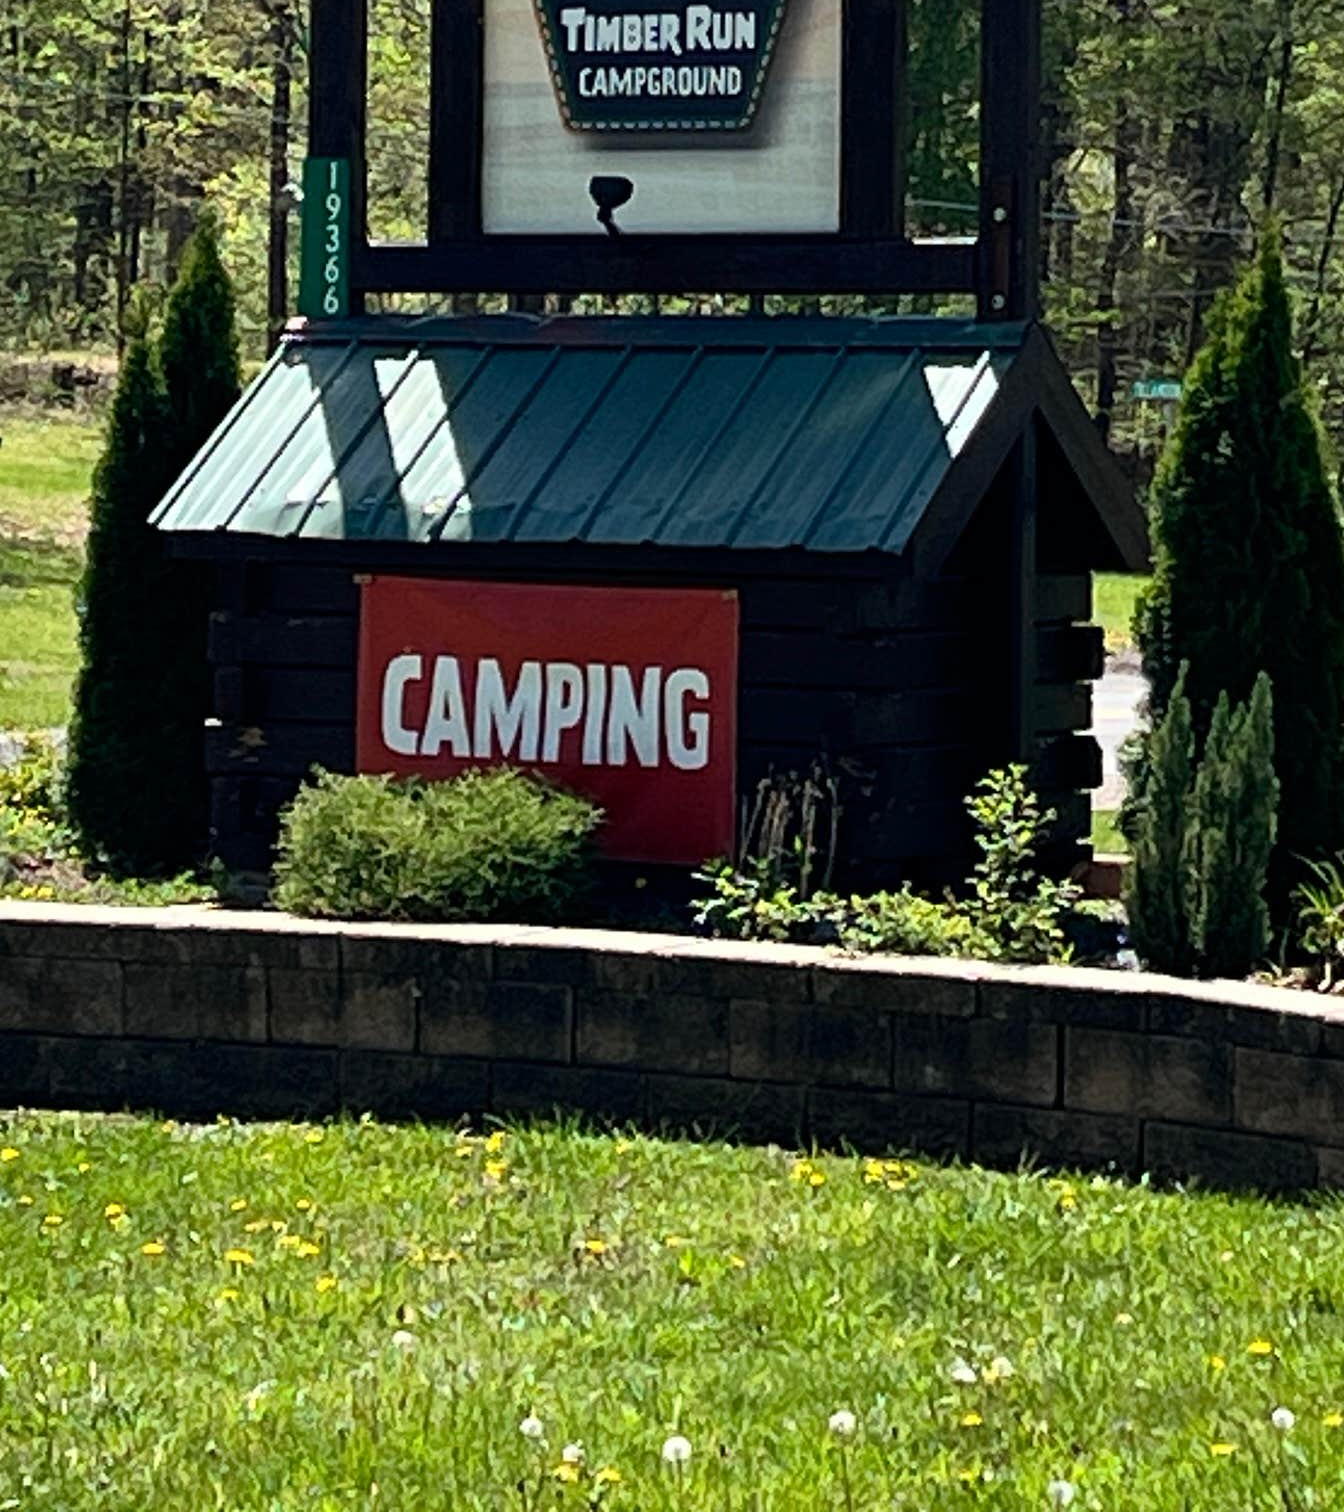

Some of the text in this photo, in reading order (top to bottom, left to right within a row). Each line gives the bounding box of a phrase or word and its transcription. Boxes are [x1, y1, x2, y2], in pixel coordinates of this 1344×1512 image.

[579, 66, 742, 96] CAMPGROUND
[323, 161, 341, 314] 19366
[381, 654, 710, 770] CAMPING
